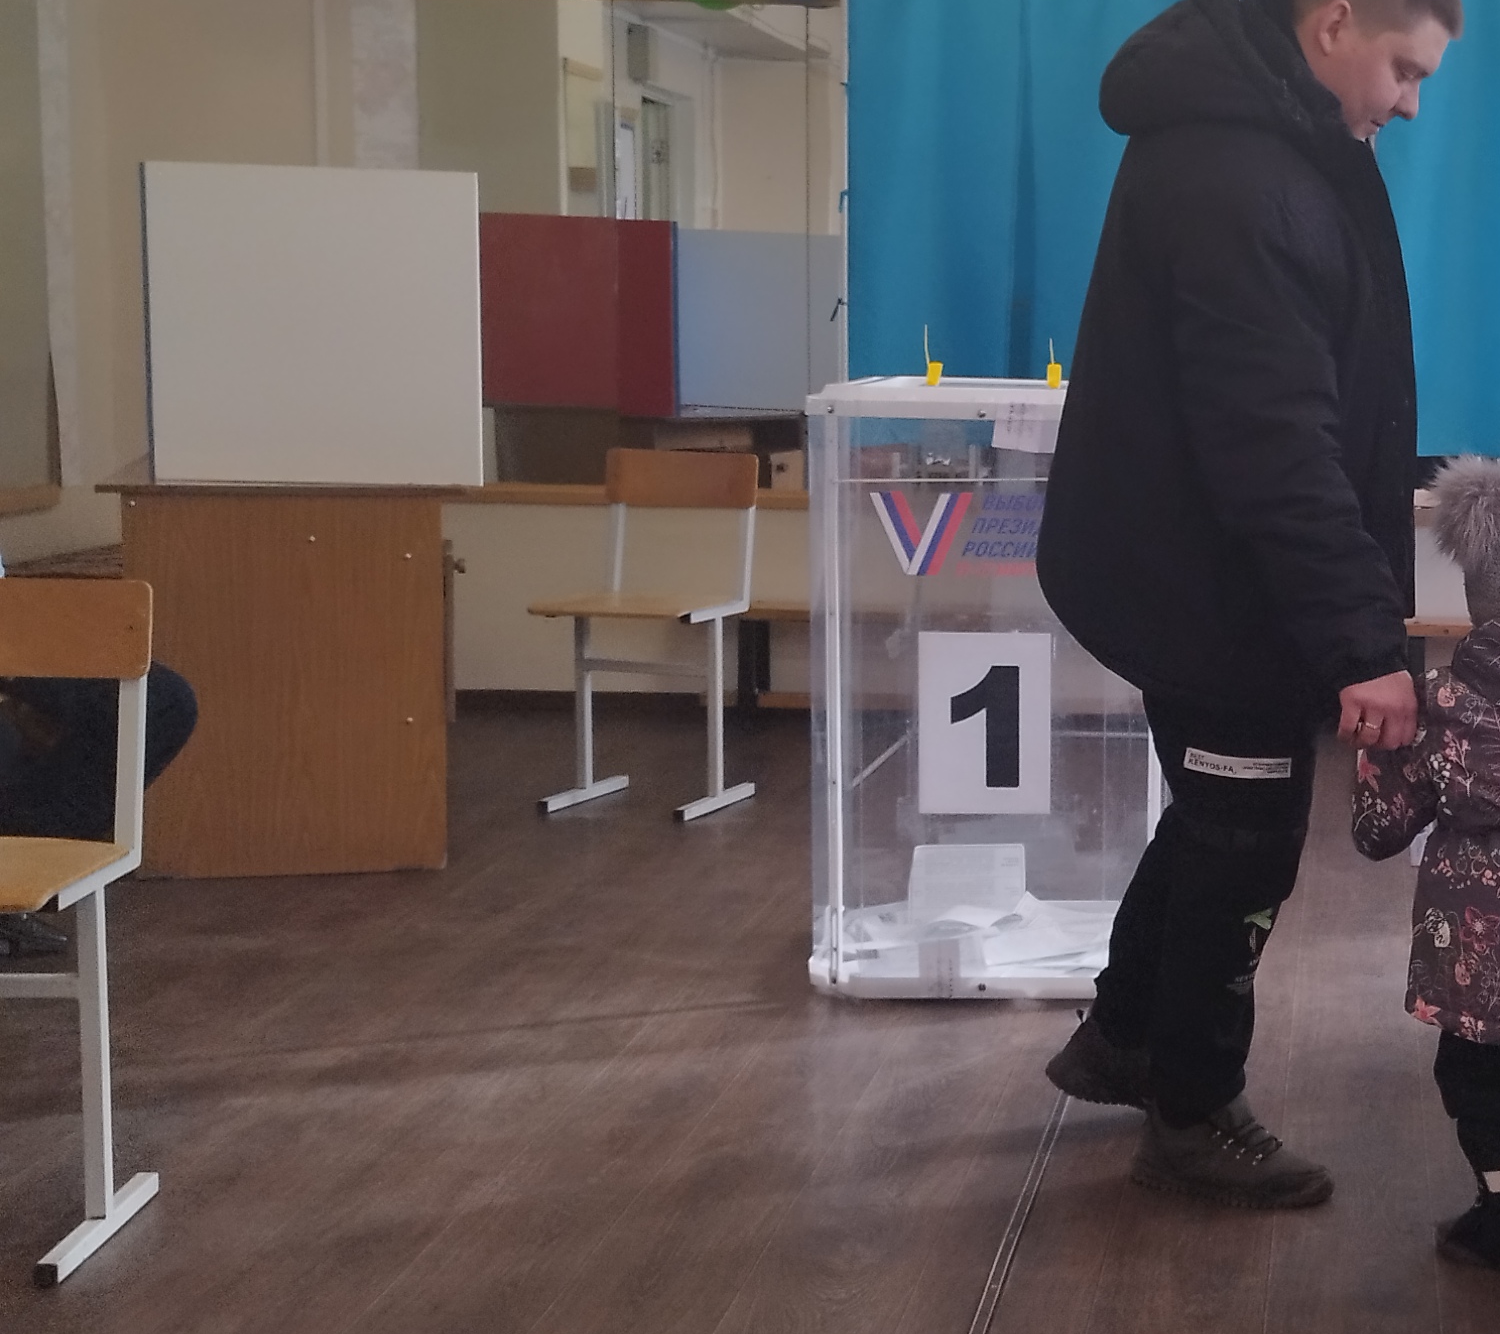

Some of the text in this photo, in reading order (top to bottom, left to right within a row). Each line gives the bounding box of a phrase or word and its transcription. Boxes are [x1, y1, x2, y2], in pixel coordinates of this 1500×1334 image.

[983, 494, 1047, 511] ВЫБО
[971, 517, 1039, 535] ПРЕЗИ
[950, 665, 1020, 788] 1
